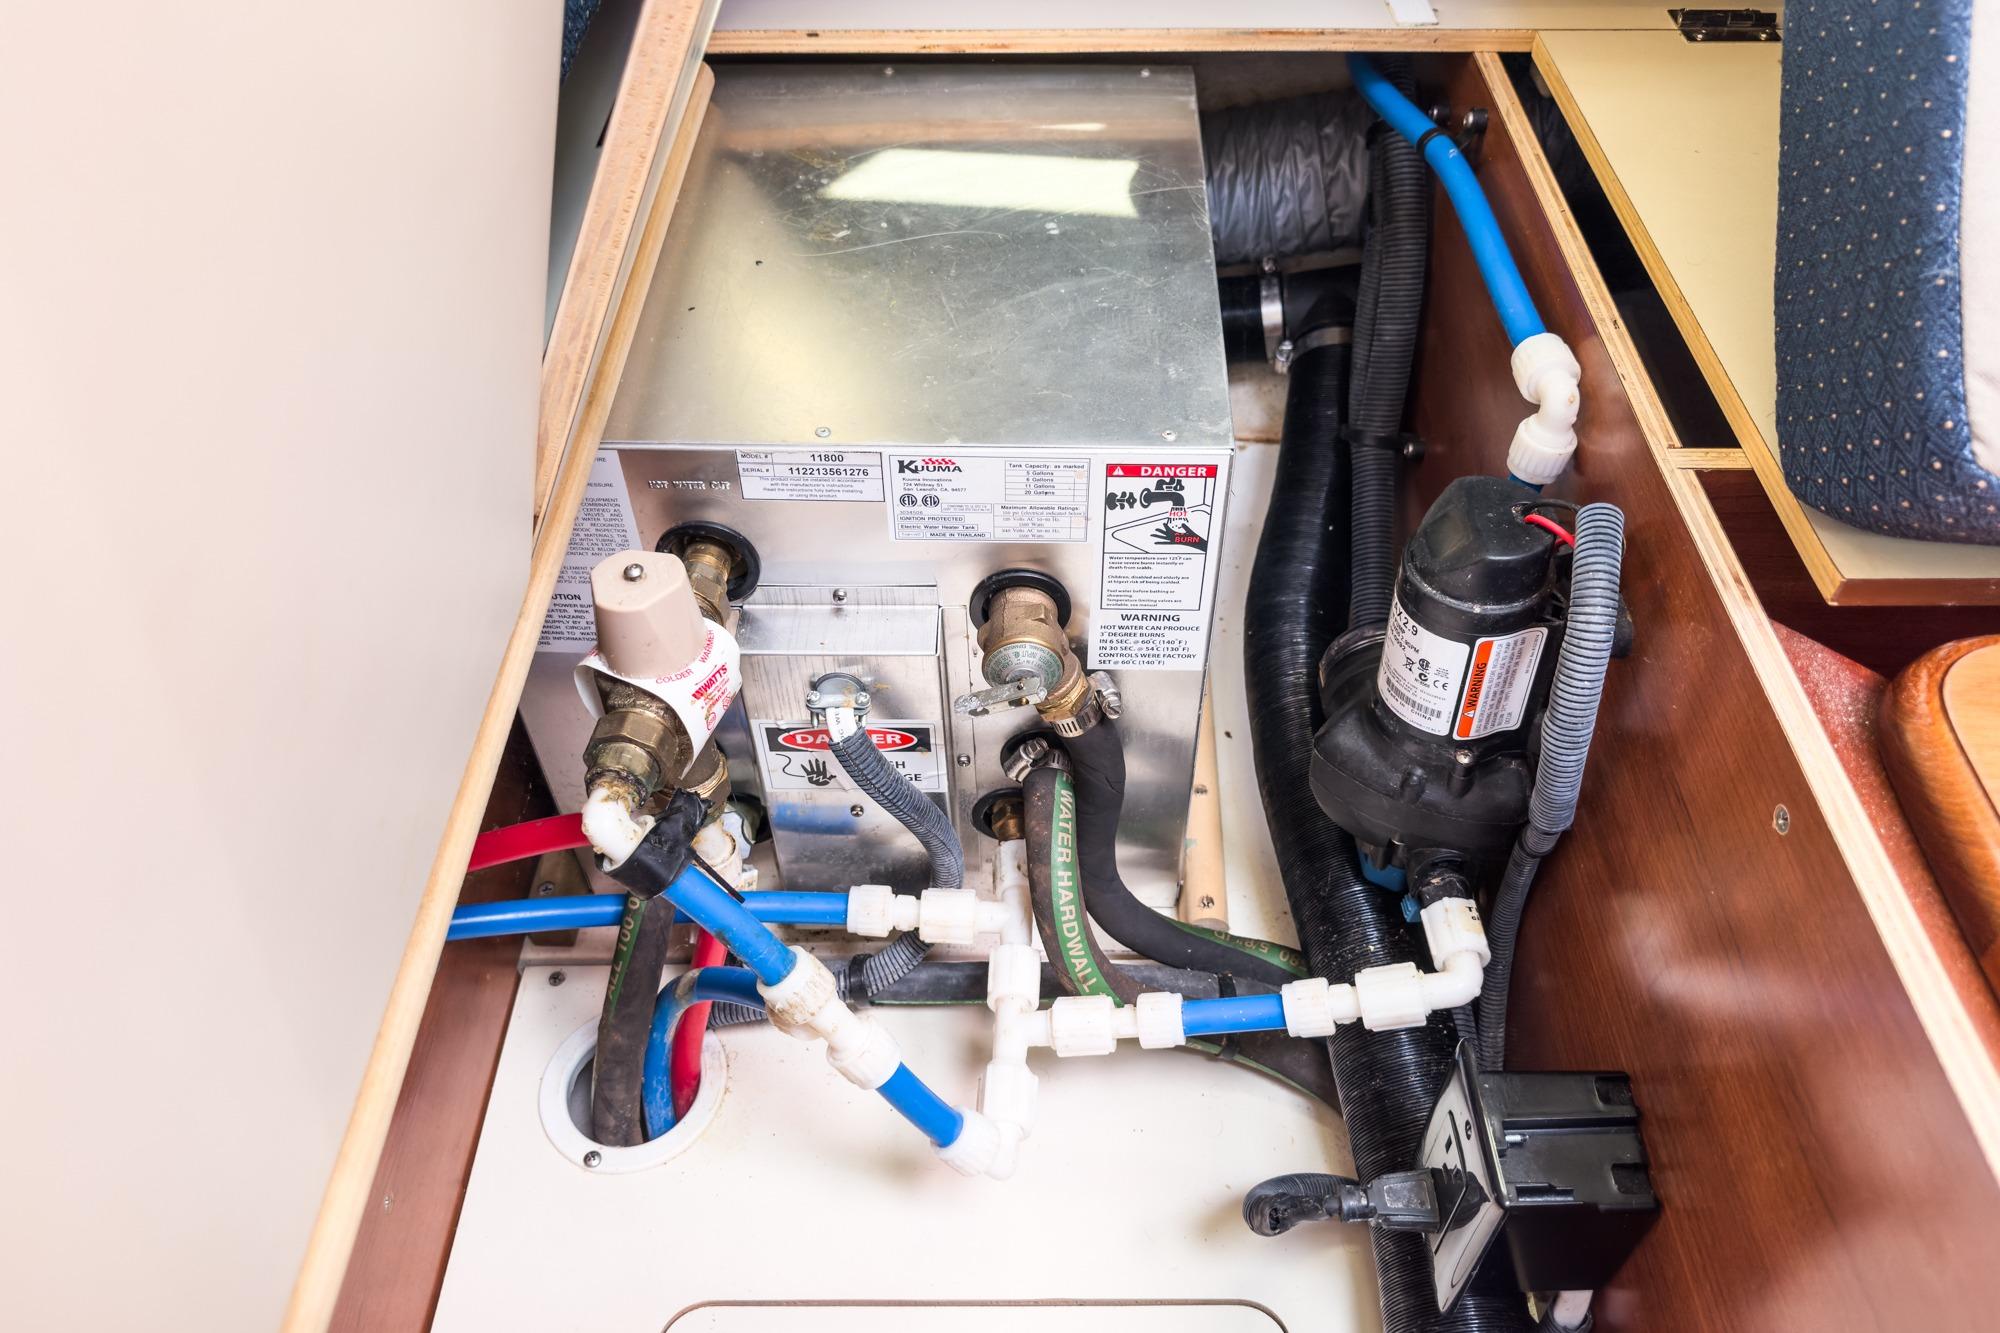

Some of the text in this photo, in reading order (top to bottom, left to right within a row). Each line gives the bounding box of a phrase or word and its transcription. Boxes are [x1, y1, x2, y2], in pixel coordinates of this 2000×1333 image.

[810, 454, 843, 462] 11800
[788, 467, 868, 476] 112213561276
[898, 460, 962, 474] KUUMA
[1140, 466, 1207, 476] DANGER
[1121, 614, 1181, 622] WARNING
[655, 668, 695, 685] COLDER
[701, 663, 728, 693] WATTS
[1467, 662, 1487, 707] WARNING
[795, 734, 903, 745] DAER
[1055, 789, 1097, 993] WATER HARDWALL
